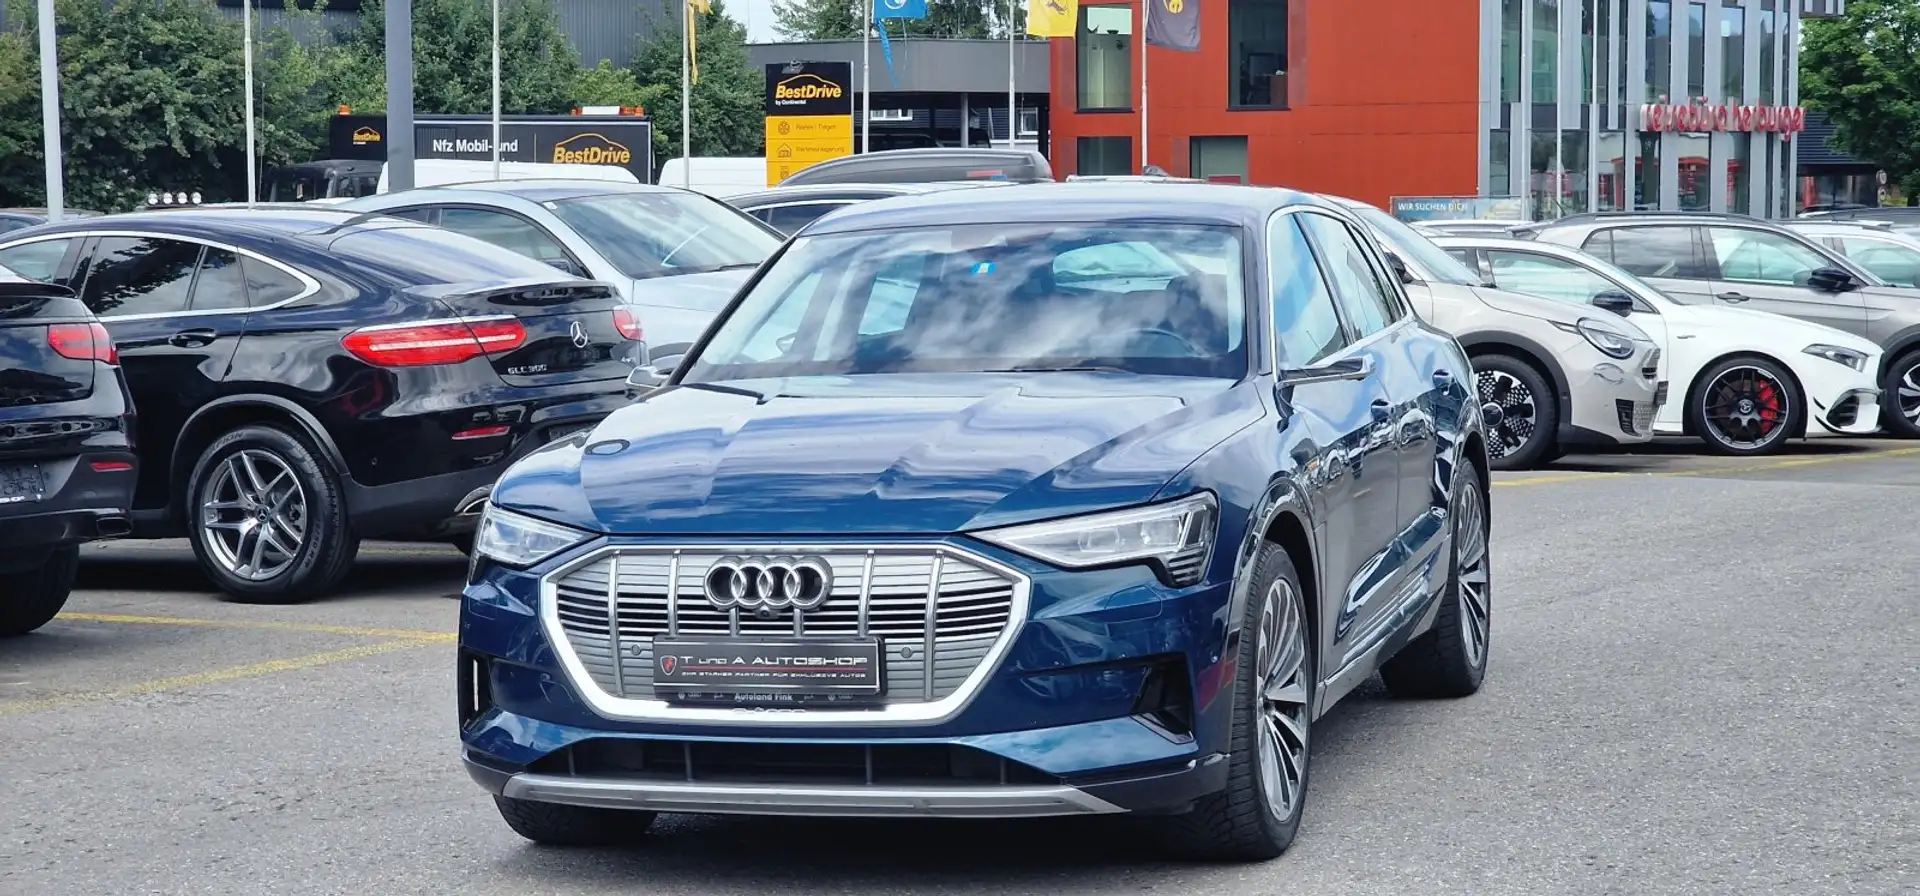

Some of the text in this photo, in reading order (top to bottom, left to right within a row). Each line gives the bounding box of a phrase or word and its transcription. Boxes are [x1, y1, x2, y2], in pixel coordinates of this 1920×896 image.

[776, 84, 842, 99] BestDrive
[433, 139, 453, 152] Nfz
[456, 139, 493, 152] Mobil-
[553, 146, 631, 164] BestDrive
[1397, 202, 1414, 211] WIR
[1415, 202, 1446, 211] SUCHEN
[507, 367, 527, 375] GLC
[680, 656, 694, 664] T
[732, 656, 746, 664] A
[752, 656, 868, 666] AUTOSHOP
